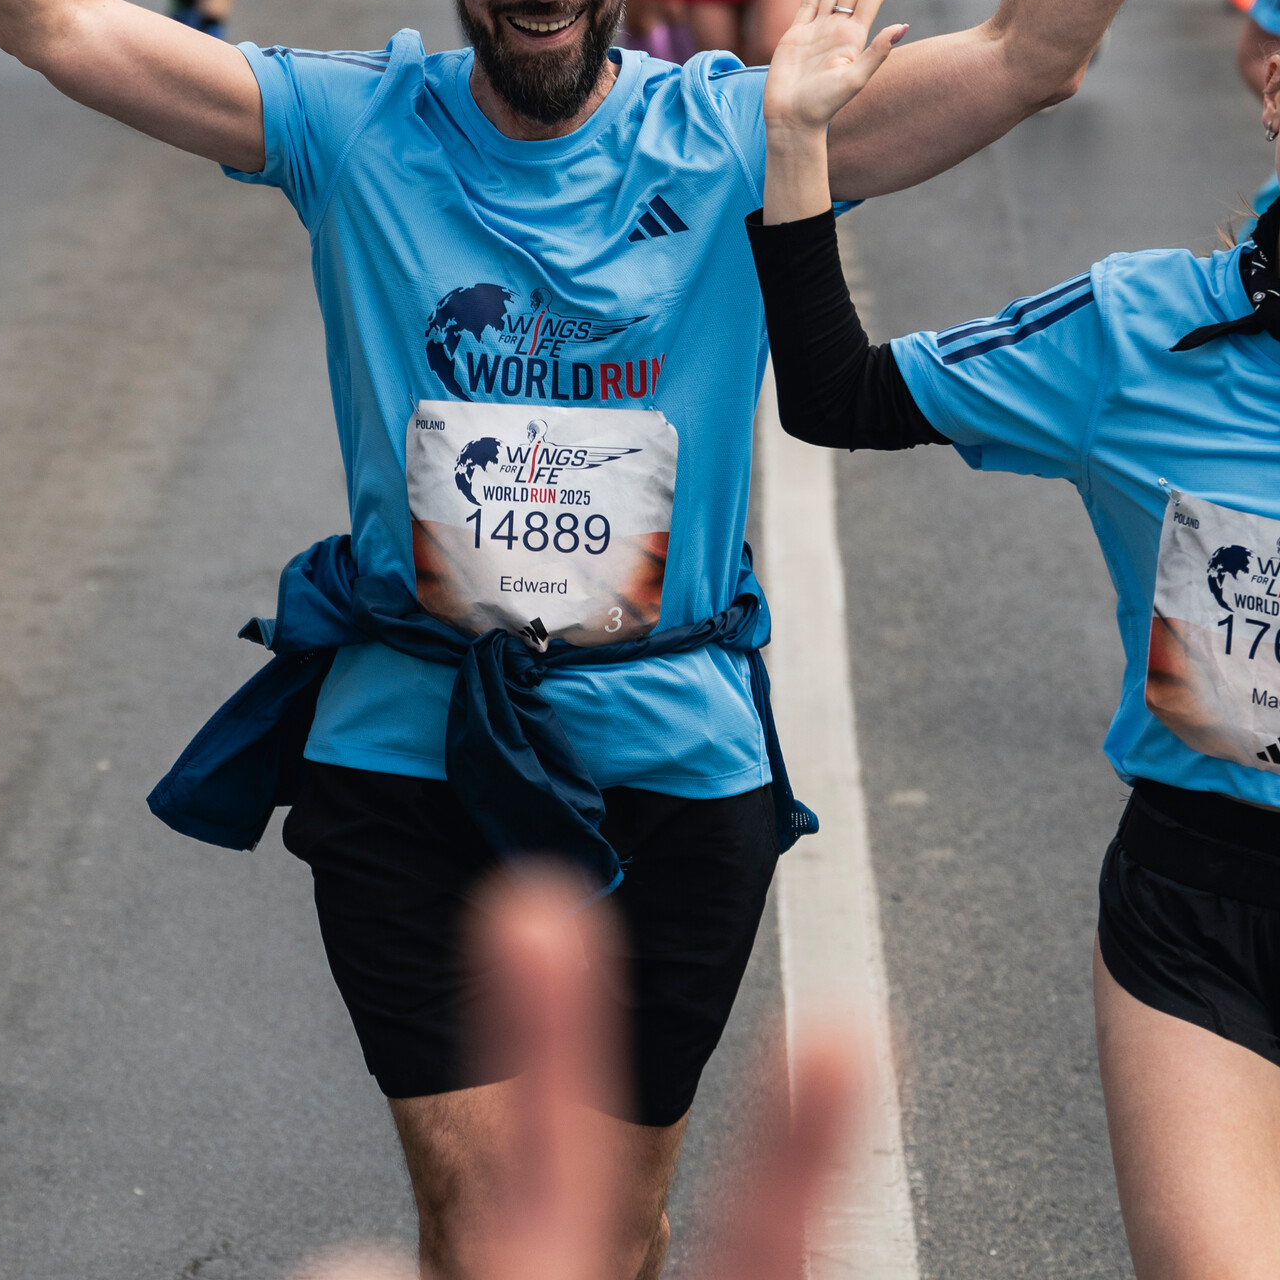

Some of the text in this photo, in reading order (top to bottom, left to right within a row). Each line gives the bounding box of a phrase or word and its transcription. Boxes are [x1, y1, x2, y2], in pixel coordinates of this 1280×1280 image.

[498, 334, 567, 359] FOR LIFE
[466, 352, 594, 401] WORLD
[415, 419, 445, 431] POLAND
[499, 465, 563, 485] FOR LIFE
[483, 485, 591, 506] WORLD RUN 2025
[1173, 511, 1200, 530] POLAND
[466, 508, 611, 556] 14889
[499, 575, 568, 595] Edward
[1251, 575, 1269, 585] FOR
[1234, 592, 1280, 618] WORLD
[604, 606, 623, 633] 3
